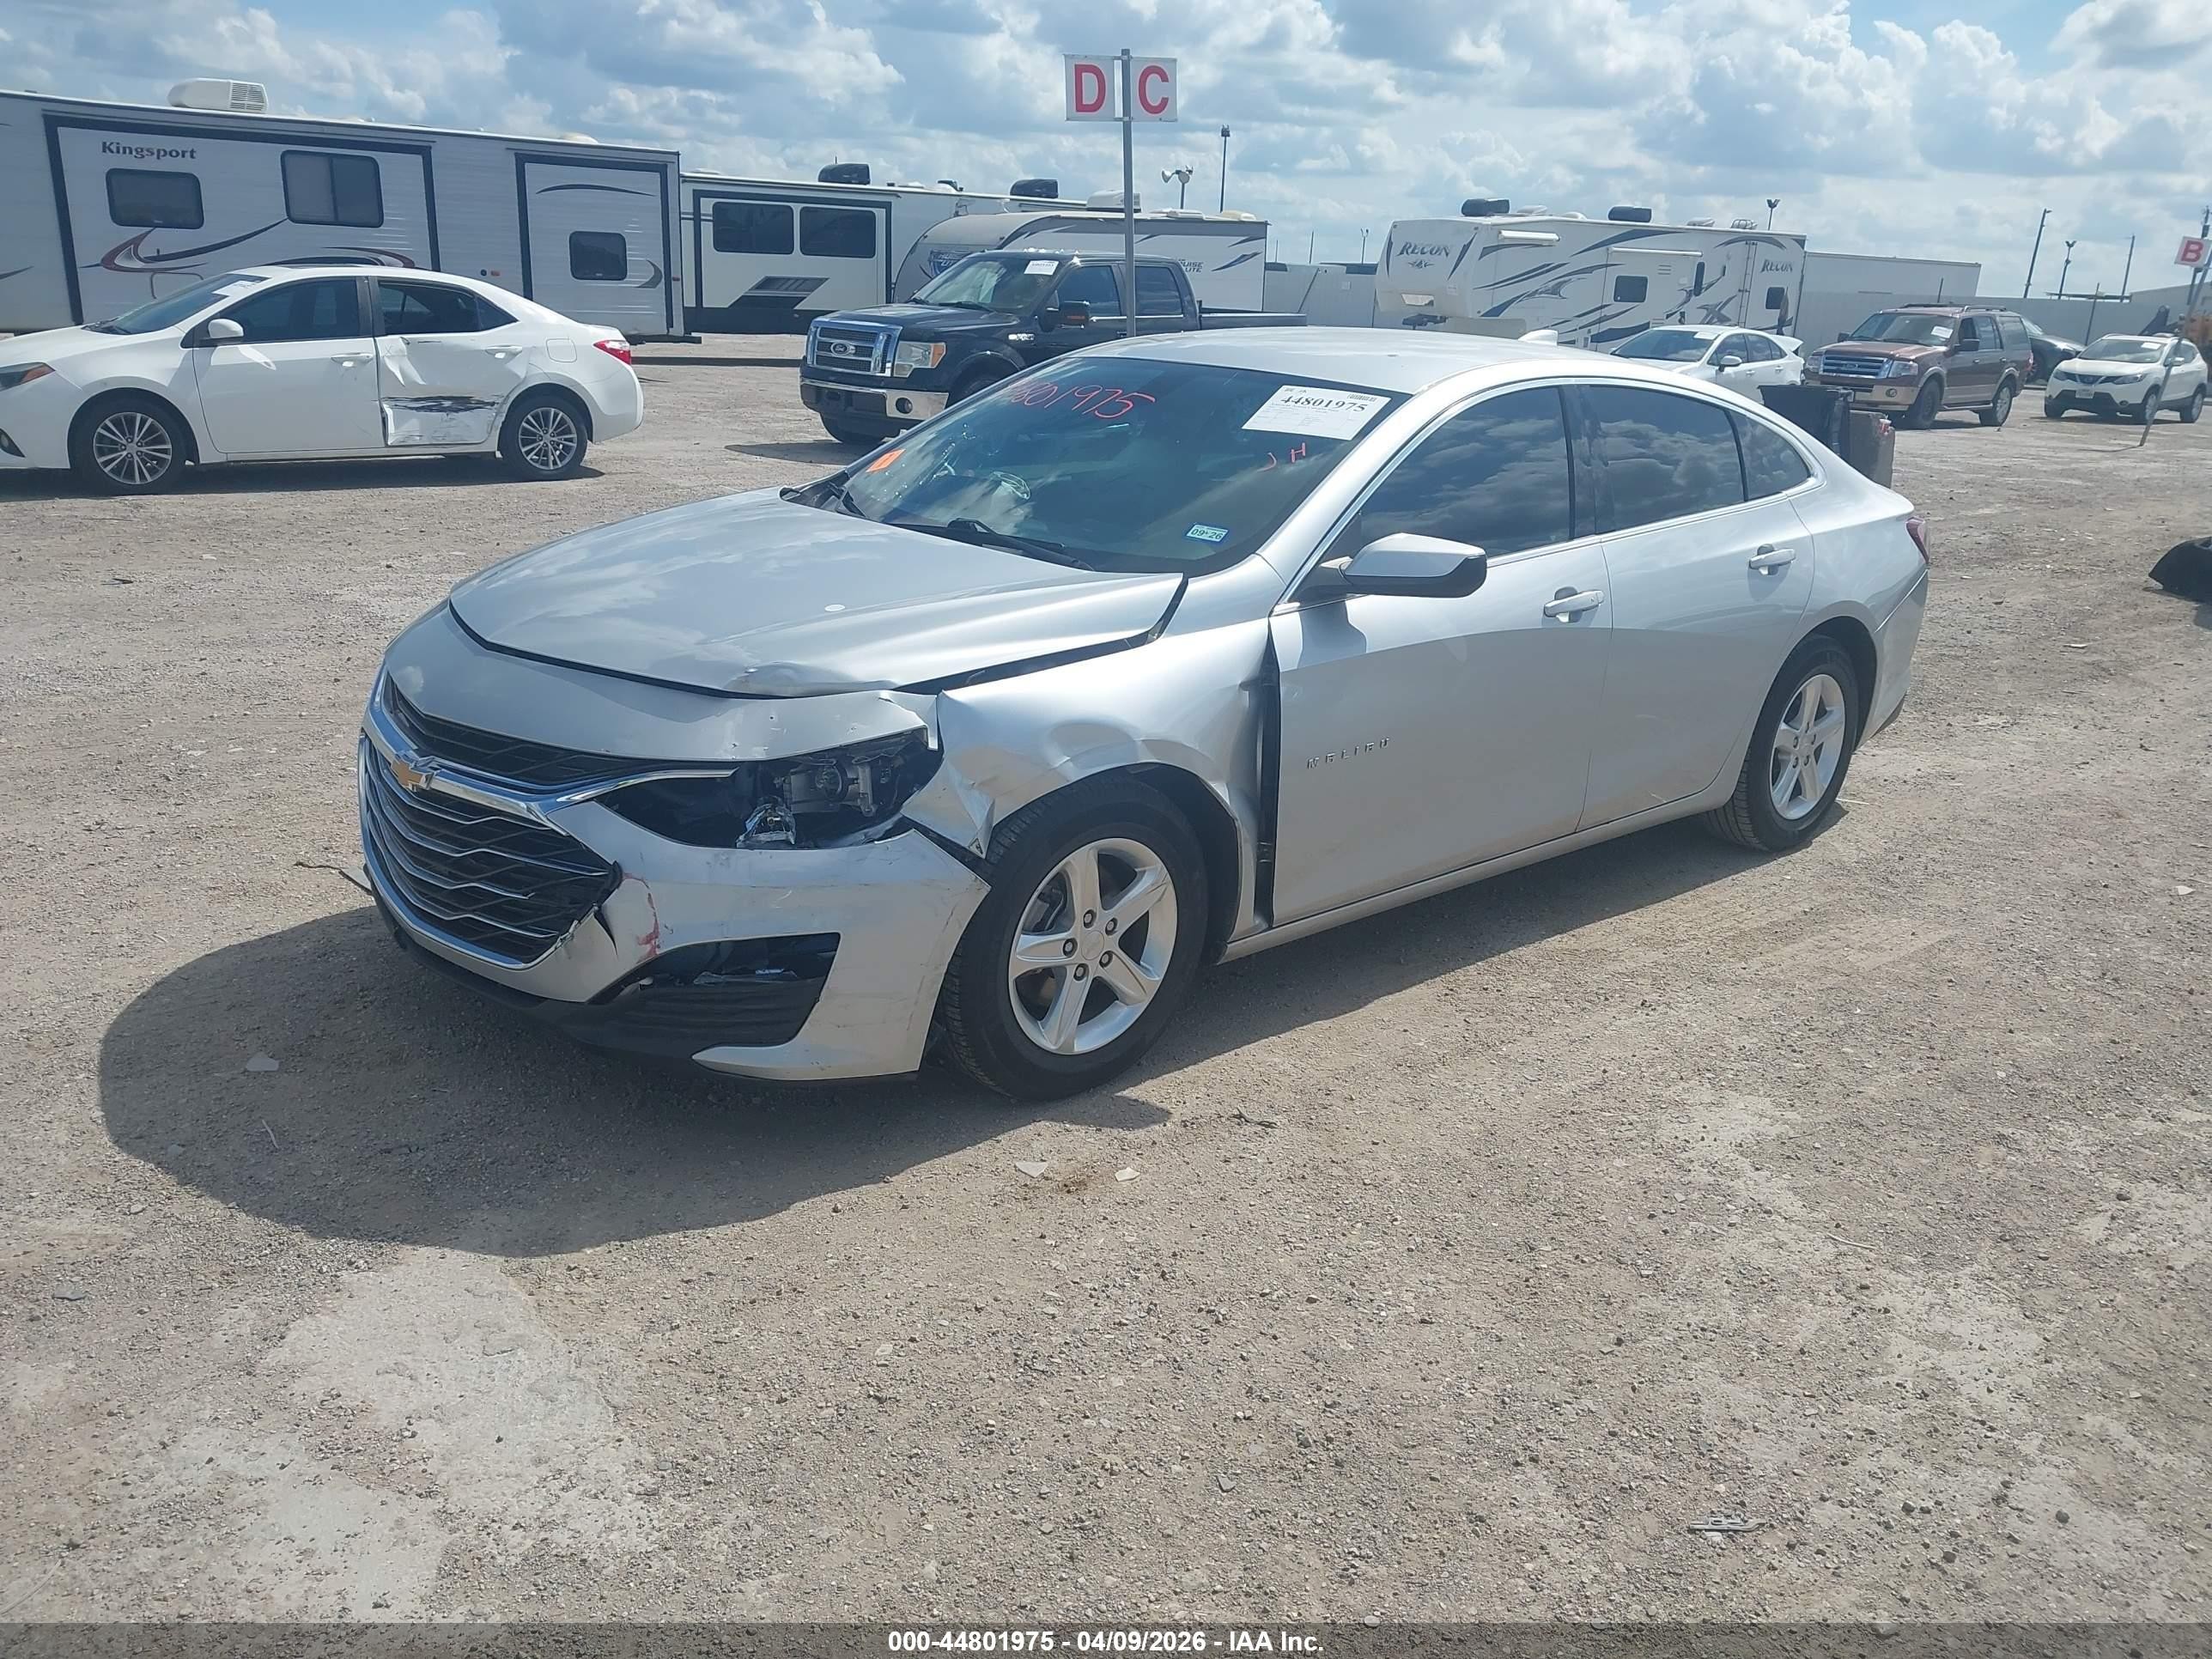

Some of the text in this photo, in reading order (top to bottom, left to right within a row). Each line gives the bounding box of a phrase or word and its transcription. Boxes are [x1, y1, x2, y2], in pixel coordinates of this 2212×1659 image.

[1074, 64, 1106, 112] D
[1138, 64, 1169, 114] C
[101, 141, 197, 160] Kingsport
[1395, 241, 1449, 258] RECON
[2181, 240, 2204, 262] B
[1759, 258, 1793, 273] RECON
[1280, 395, 1368, 413] 44801975
